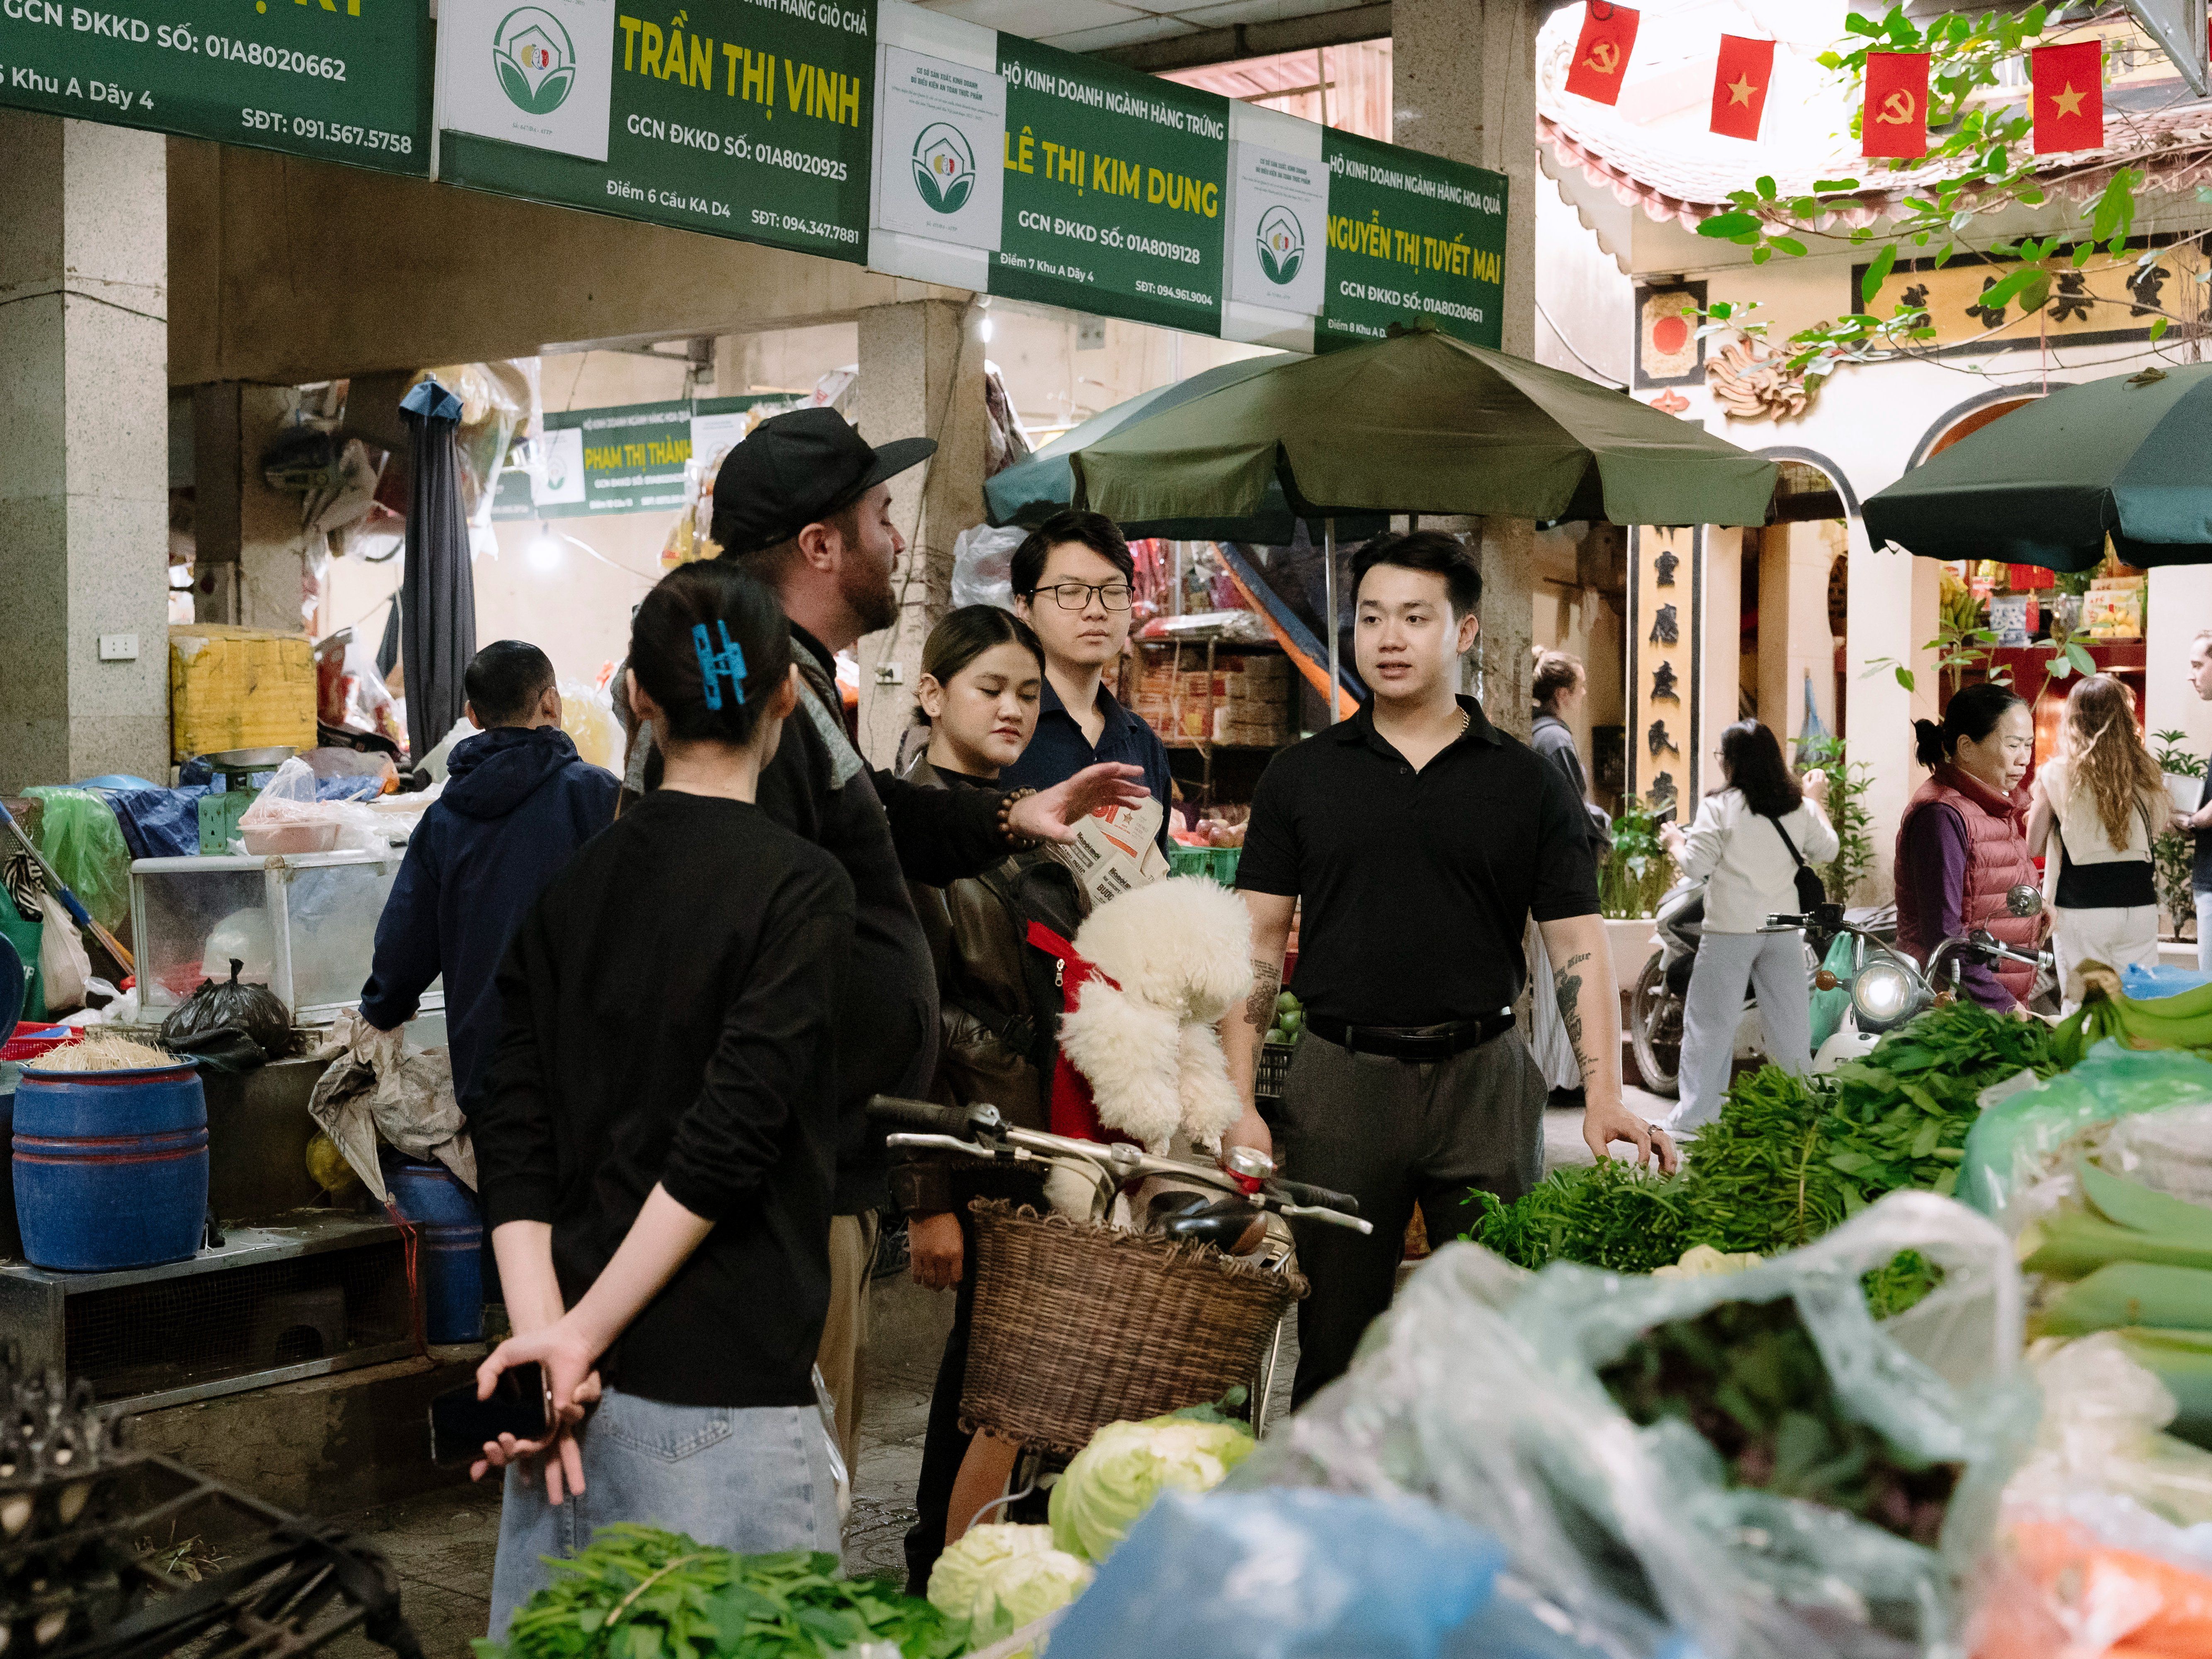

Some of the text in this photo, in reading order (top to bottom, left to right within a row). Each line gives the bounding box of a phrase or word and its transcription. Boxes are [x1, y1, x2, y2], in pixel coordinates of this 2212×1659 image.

[4, 0, 346, 81] GCN ĐKKD SỐ: 01A8020662
[818, 2, 840, 27] GIÒ
[843, 9, 867, 36] CHẢ
[12, 66, 58, 93] Khu
[66, 77, 83, 98] A
[90, 80, 133, 110] Dãy
[139, 90, 154, 109] 4
[620, 10, 859, 127] TRẦN THỊ VINH
[1001, 61, 1224, 140] HỘ KINH DOANH NGÀNH HÀNG TRỨNG
[242, 108, 412, 154] SĐT: 091.567.5758
[627, 114, 847, 181] GCN ĐKKD SỐ: 01A8020925
[1004, 126, 1034, 174] LÊ
[1042, 141, 1085, 196] THỊ
[1093, 155, 1140, 199] KIM
[1148, 168, 1218, 218] DUNG
[1330, 153, 1344, 178] HỘ
[1346, 160, 1369, 180] KINH
[1370, 166, 1403, 189] DOANH
[1405, 175, 1436, 197] NGÀNH
[1437, 181, 1462, 204] HÀNG
[1463, 190, 1481, 209] HOA
[1483, 194, 1501, 215] QUẢ
[606, 180, 731, 218] Điểm 6 Cầu KA D4
[751, 209, 858, 243] SĐT: 094.347.7881
[1018, 210, 1200, 265] GCN ĐKKD SỐ: 01A8019128
[1000, 251, 1094, 282] Điểm 7 Khu A Dãy 4
[1395, 230, 1420, 274] THỊ
[1423, 233, 1471, 276] TUYẾT
[1473, 249, 1500, 284] MAI
[1135, 280, 1213, 306] SĐT: 094.961.9004
[1340, 281, 1483, 323] GCN ĐKKD SỐ: 01A8020661
